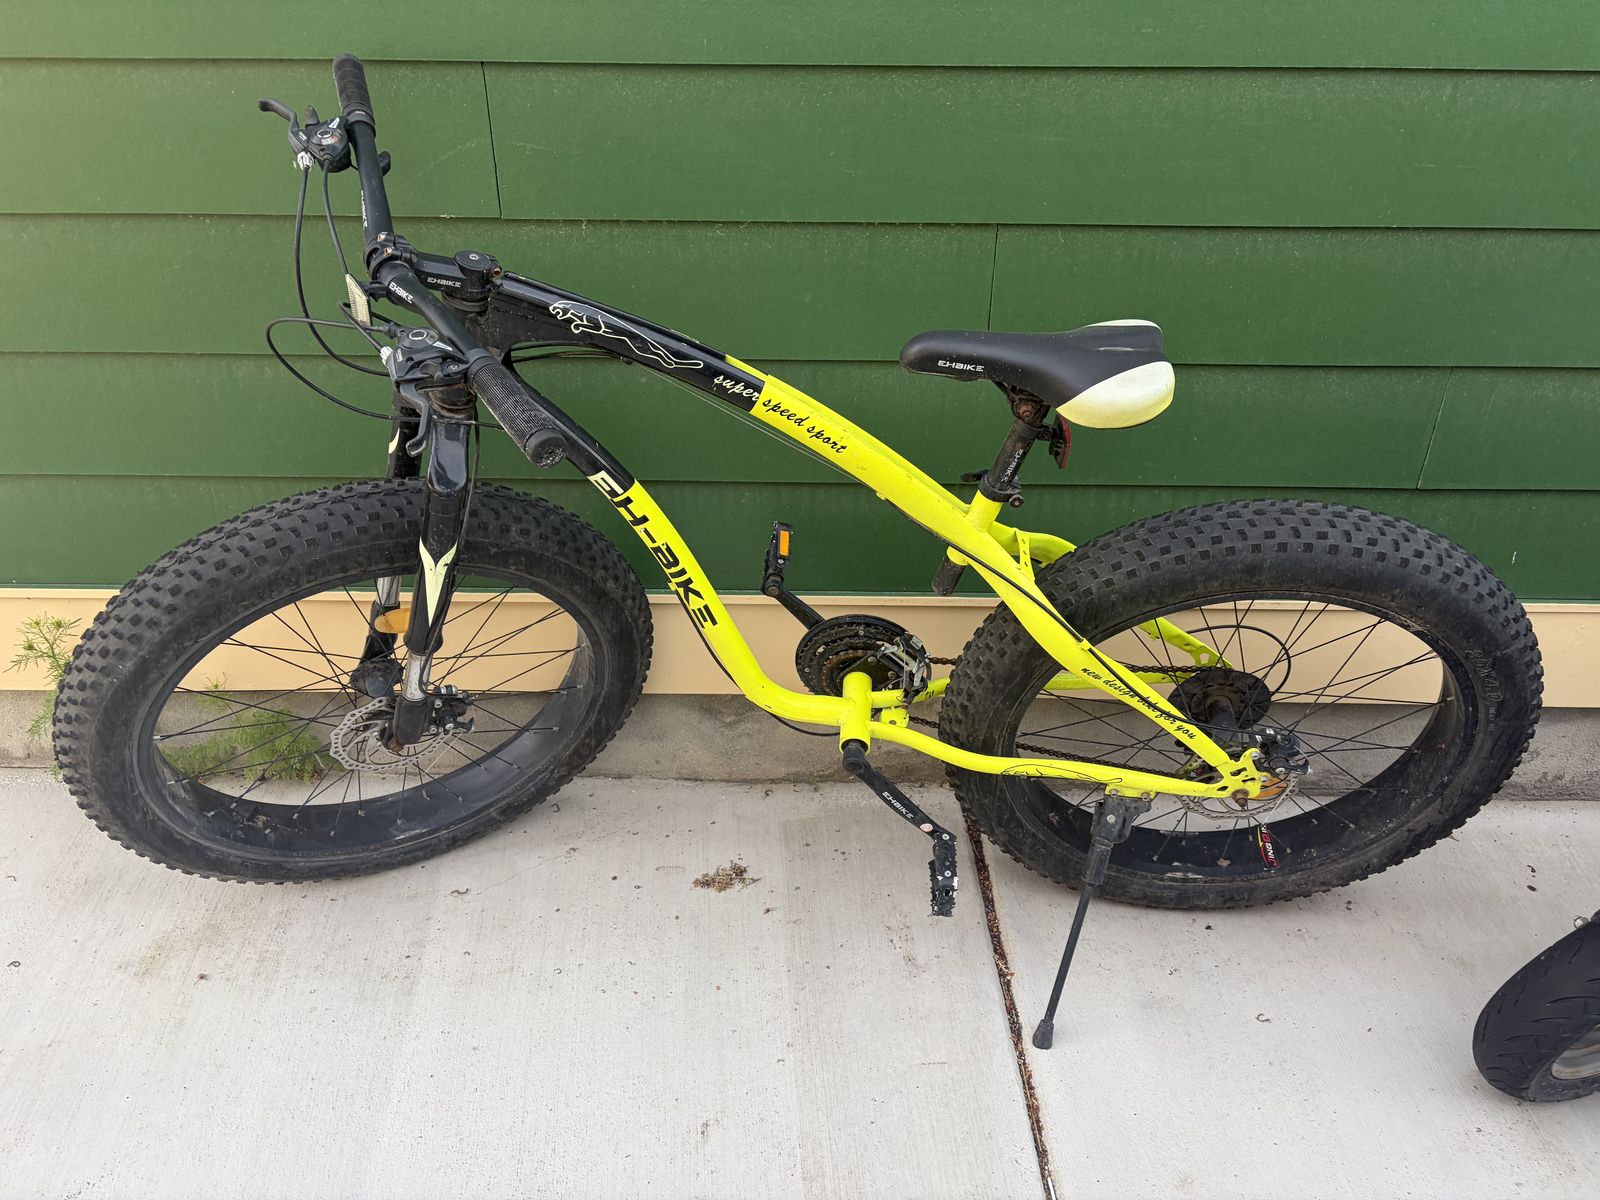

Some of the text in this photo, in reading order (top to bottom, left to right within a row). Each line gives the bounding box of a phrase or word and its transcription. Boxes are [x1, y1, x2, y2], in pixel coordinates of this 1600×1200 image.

[388, 281, 413, 304] EHBIKE
[427, 277, 462, 288] EHBIKE
[937, 360, 985, 372] EHBIKE
[713, 374, 848, 454] super speed sport
[1080, 667, 1103, 680] new
[1102, 679, 1137, 699] design
[1173, 724, 1197, 740] you
[881, 791, 915, 819] EHBIKE
